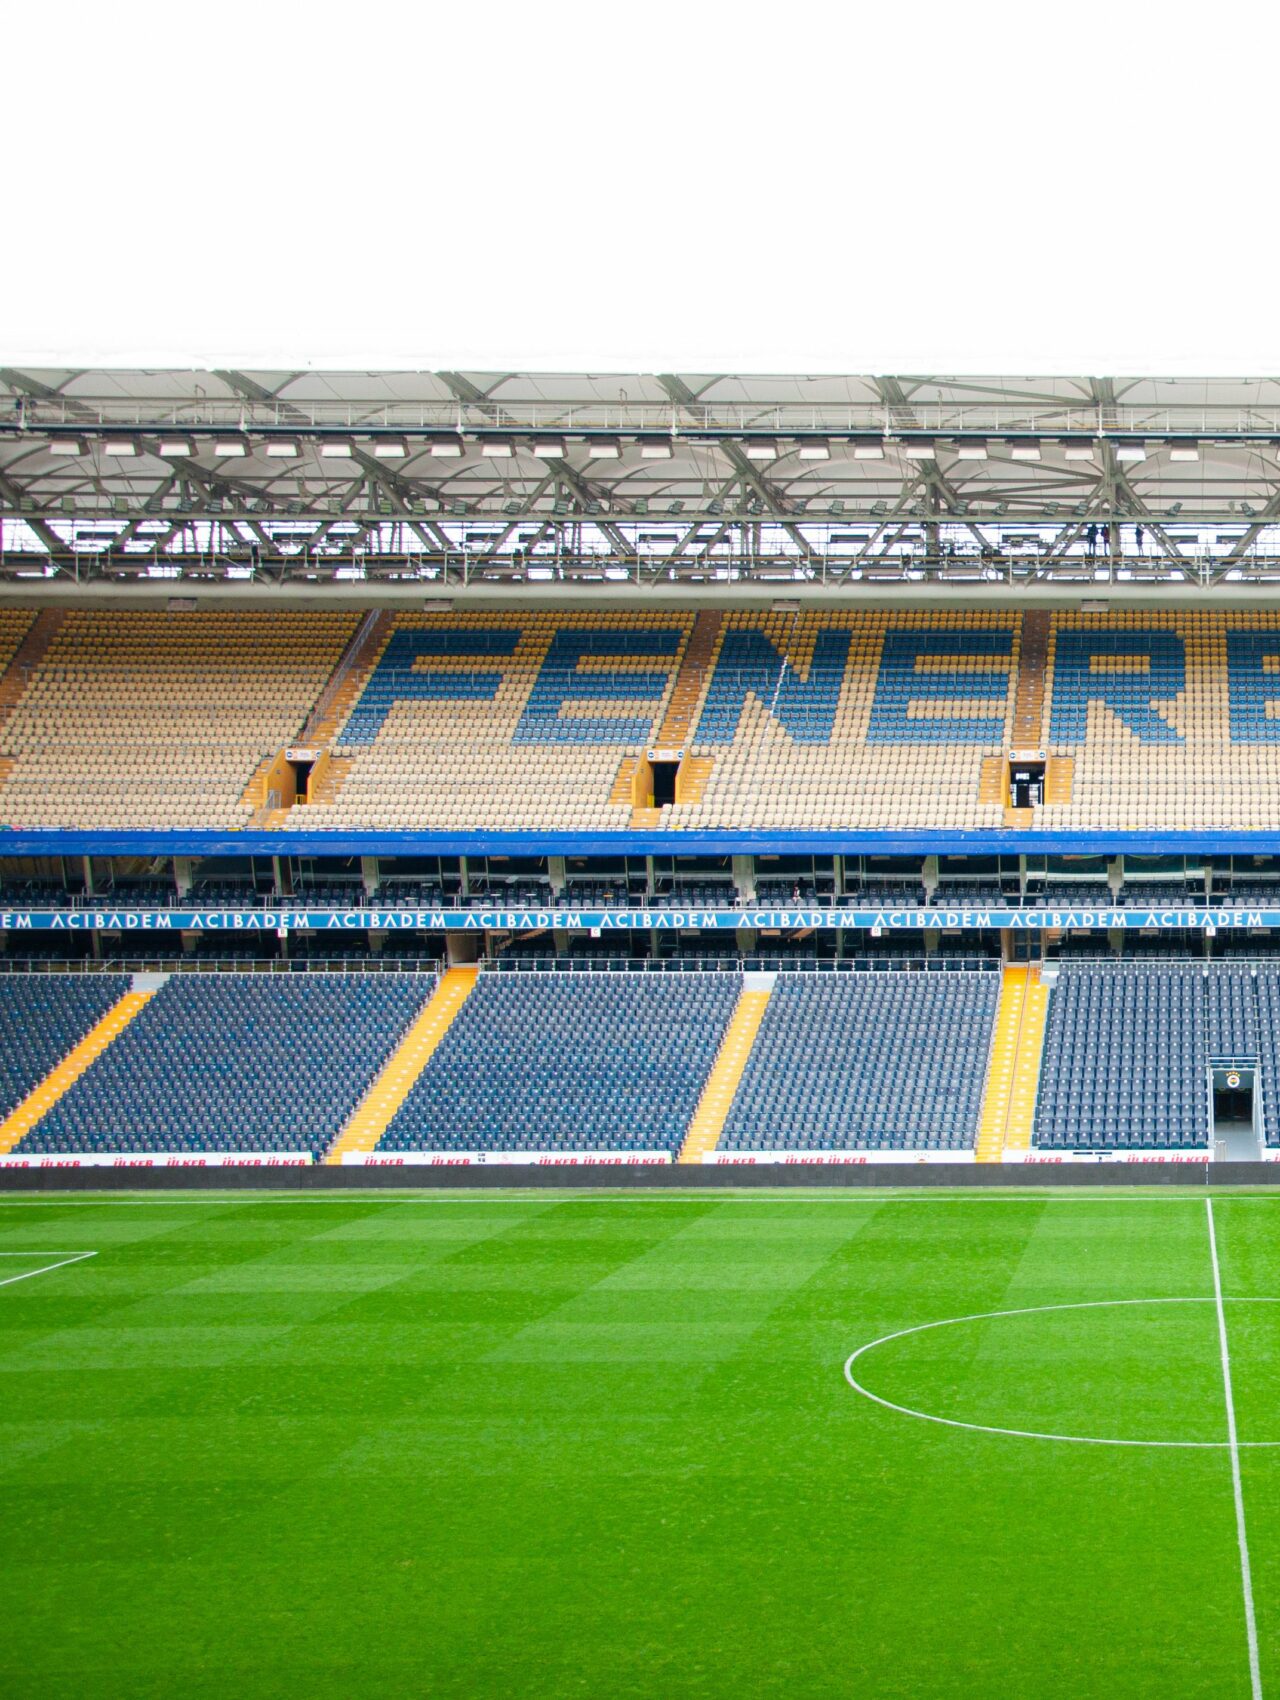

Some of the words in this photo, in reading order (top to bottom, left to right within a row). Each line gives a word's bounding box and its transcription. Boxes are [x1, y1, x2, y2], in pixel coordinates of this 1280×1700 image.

[51, 914, 171, 928] ACIBADEM
[191, 914, 308, 927] ACIBADEM
[328, 914, 445, 927] ACIBADEM
[465, 914, 581, 927] ACIBADEM
[601, 913, 717, 927] ACIBADEM
[738, 913, 855, 927] ACIBADEM
[874, 913, 991, 927] ACIBADEM
[1010, 913, 1126, 926] ACIBADEM
[1145, 913, 1262, 926] ACIBADEM
